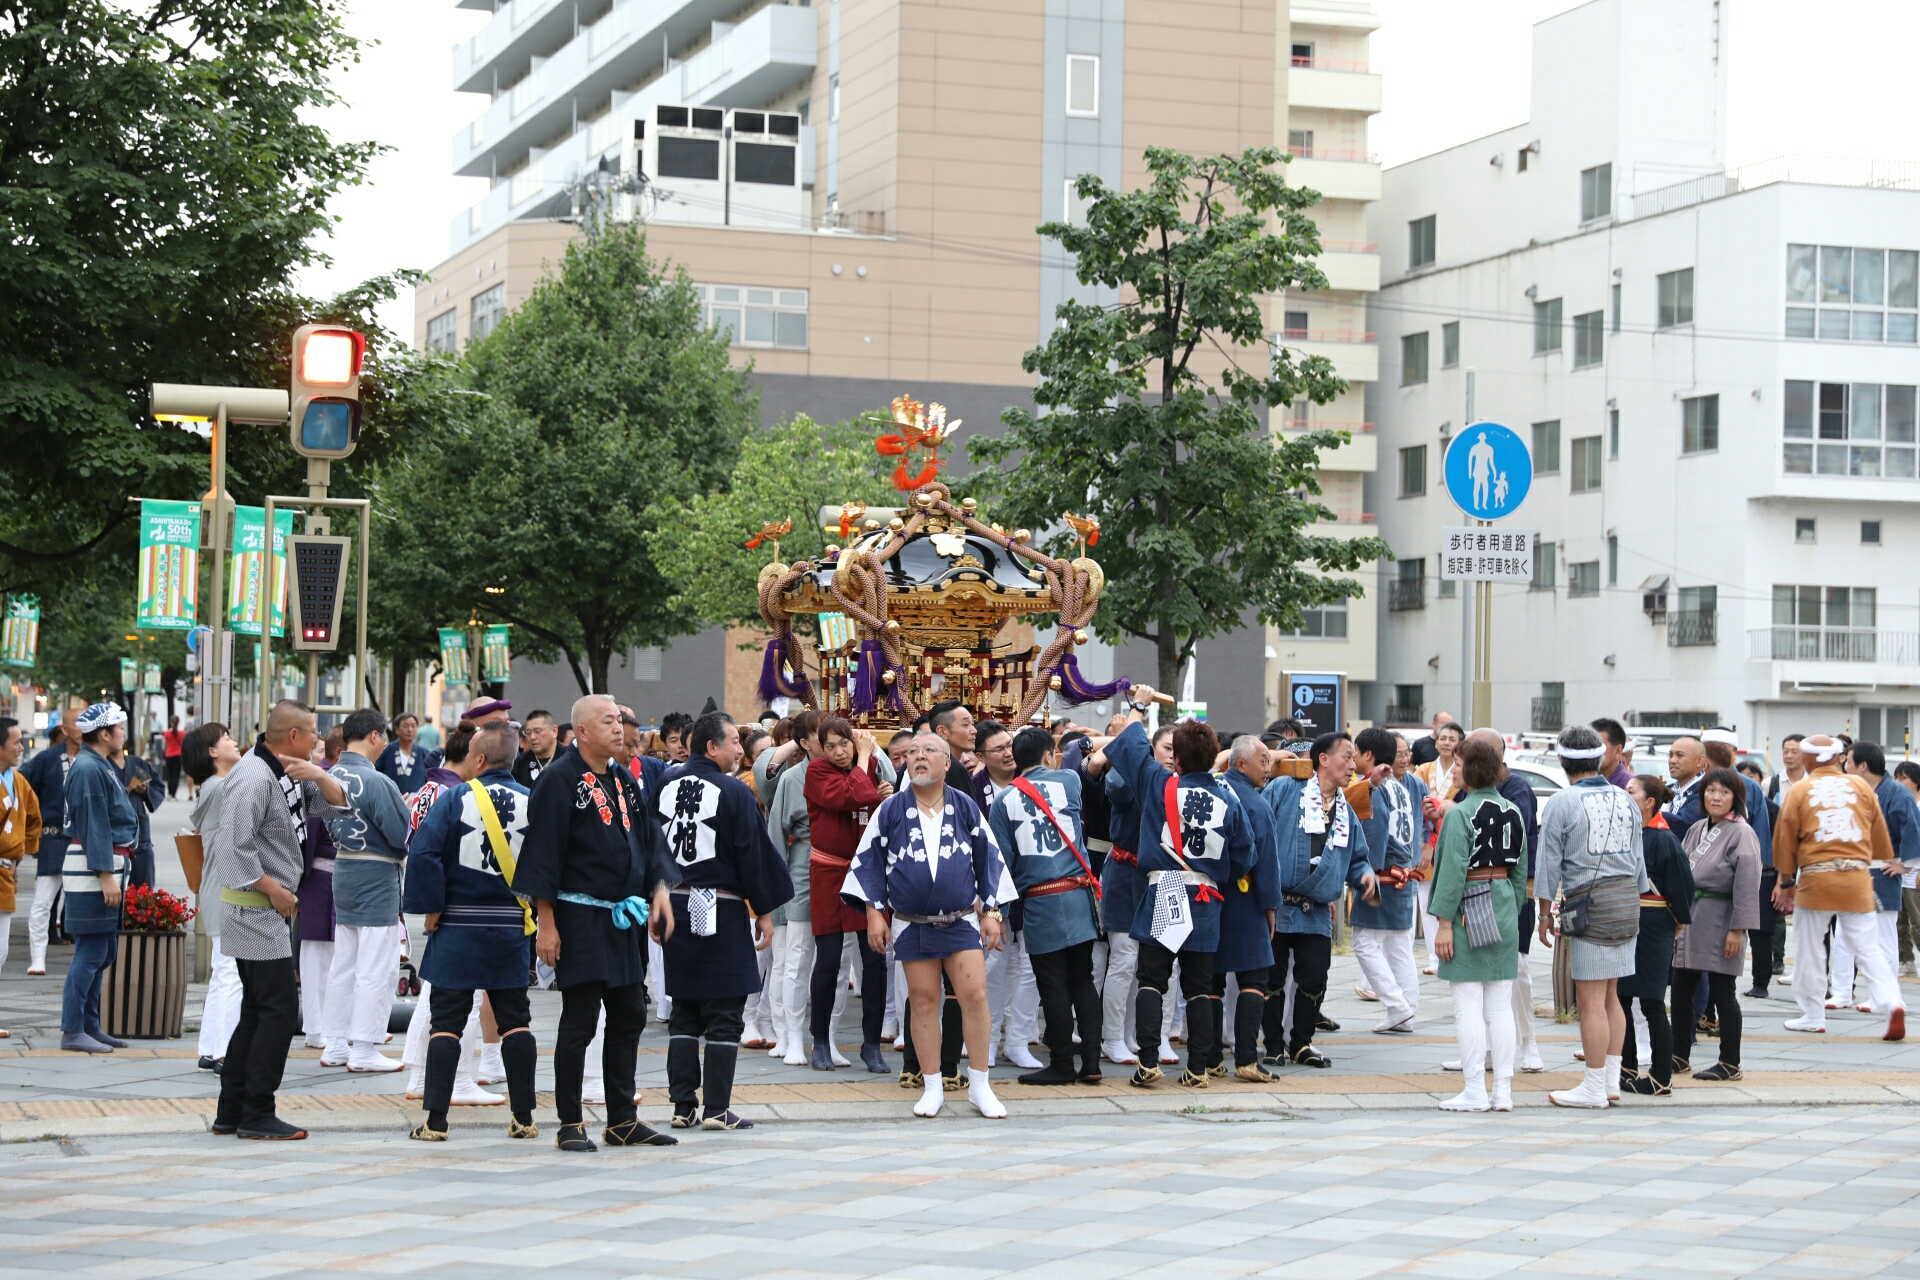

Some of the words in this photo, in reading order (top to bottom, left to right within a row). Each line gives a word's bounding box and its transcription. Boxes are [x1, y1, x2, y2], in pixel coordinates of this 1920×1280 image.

[167, 525, 192, 536] 50th
[259, 533, 284, 543] 5th
[1450, 533, 1526, 551] 歩行者用道路
[157, 553, 168, 610] 未来へつなぐ
[248, 560, 260, 617] 未来へつなぐ
[1807, 776, 1863, 842] 春風
